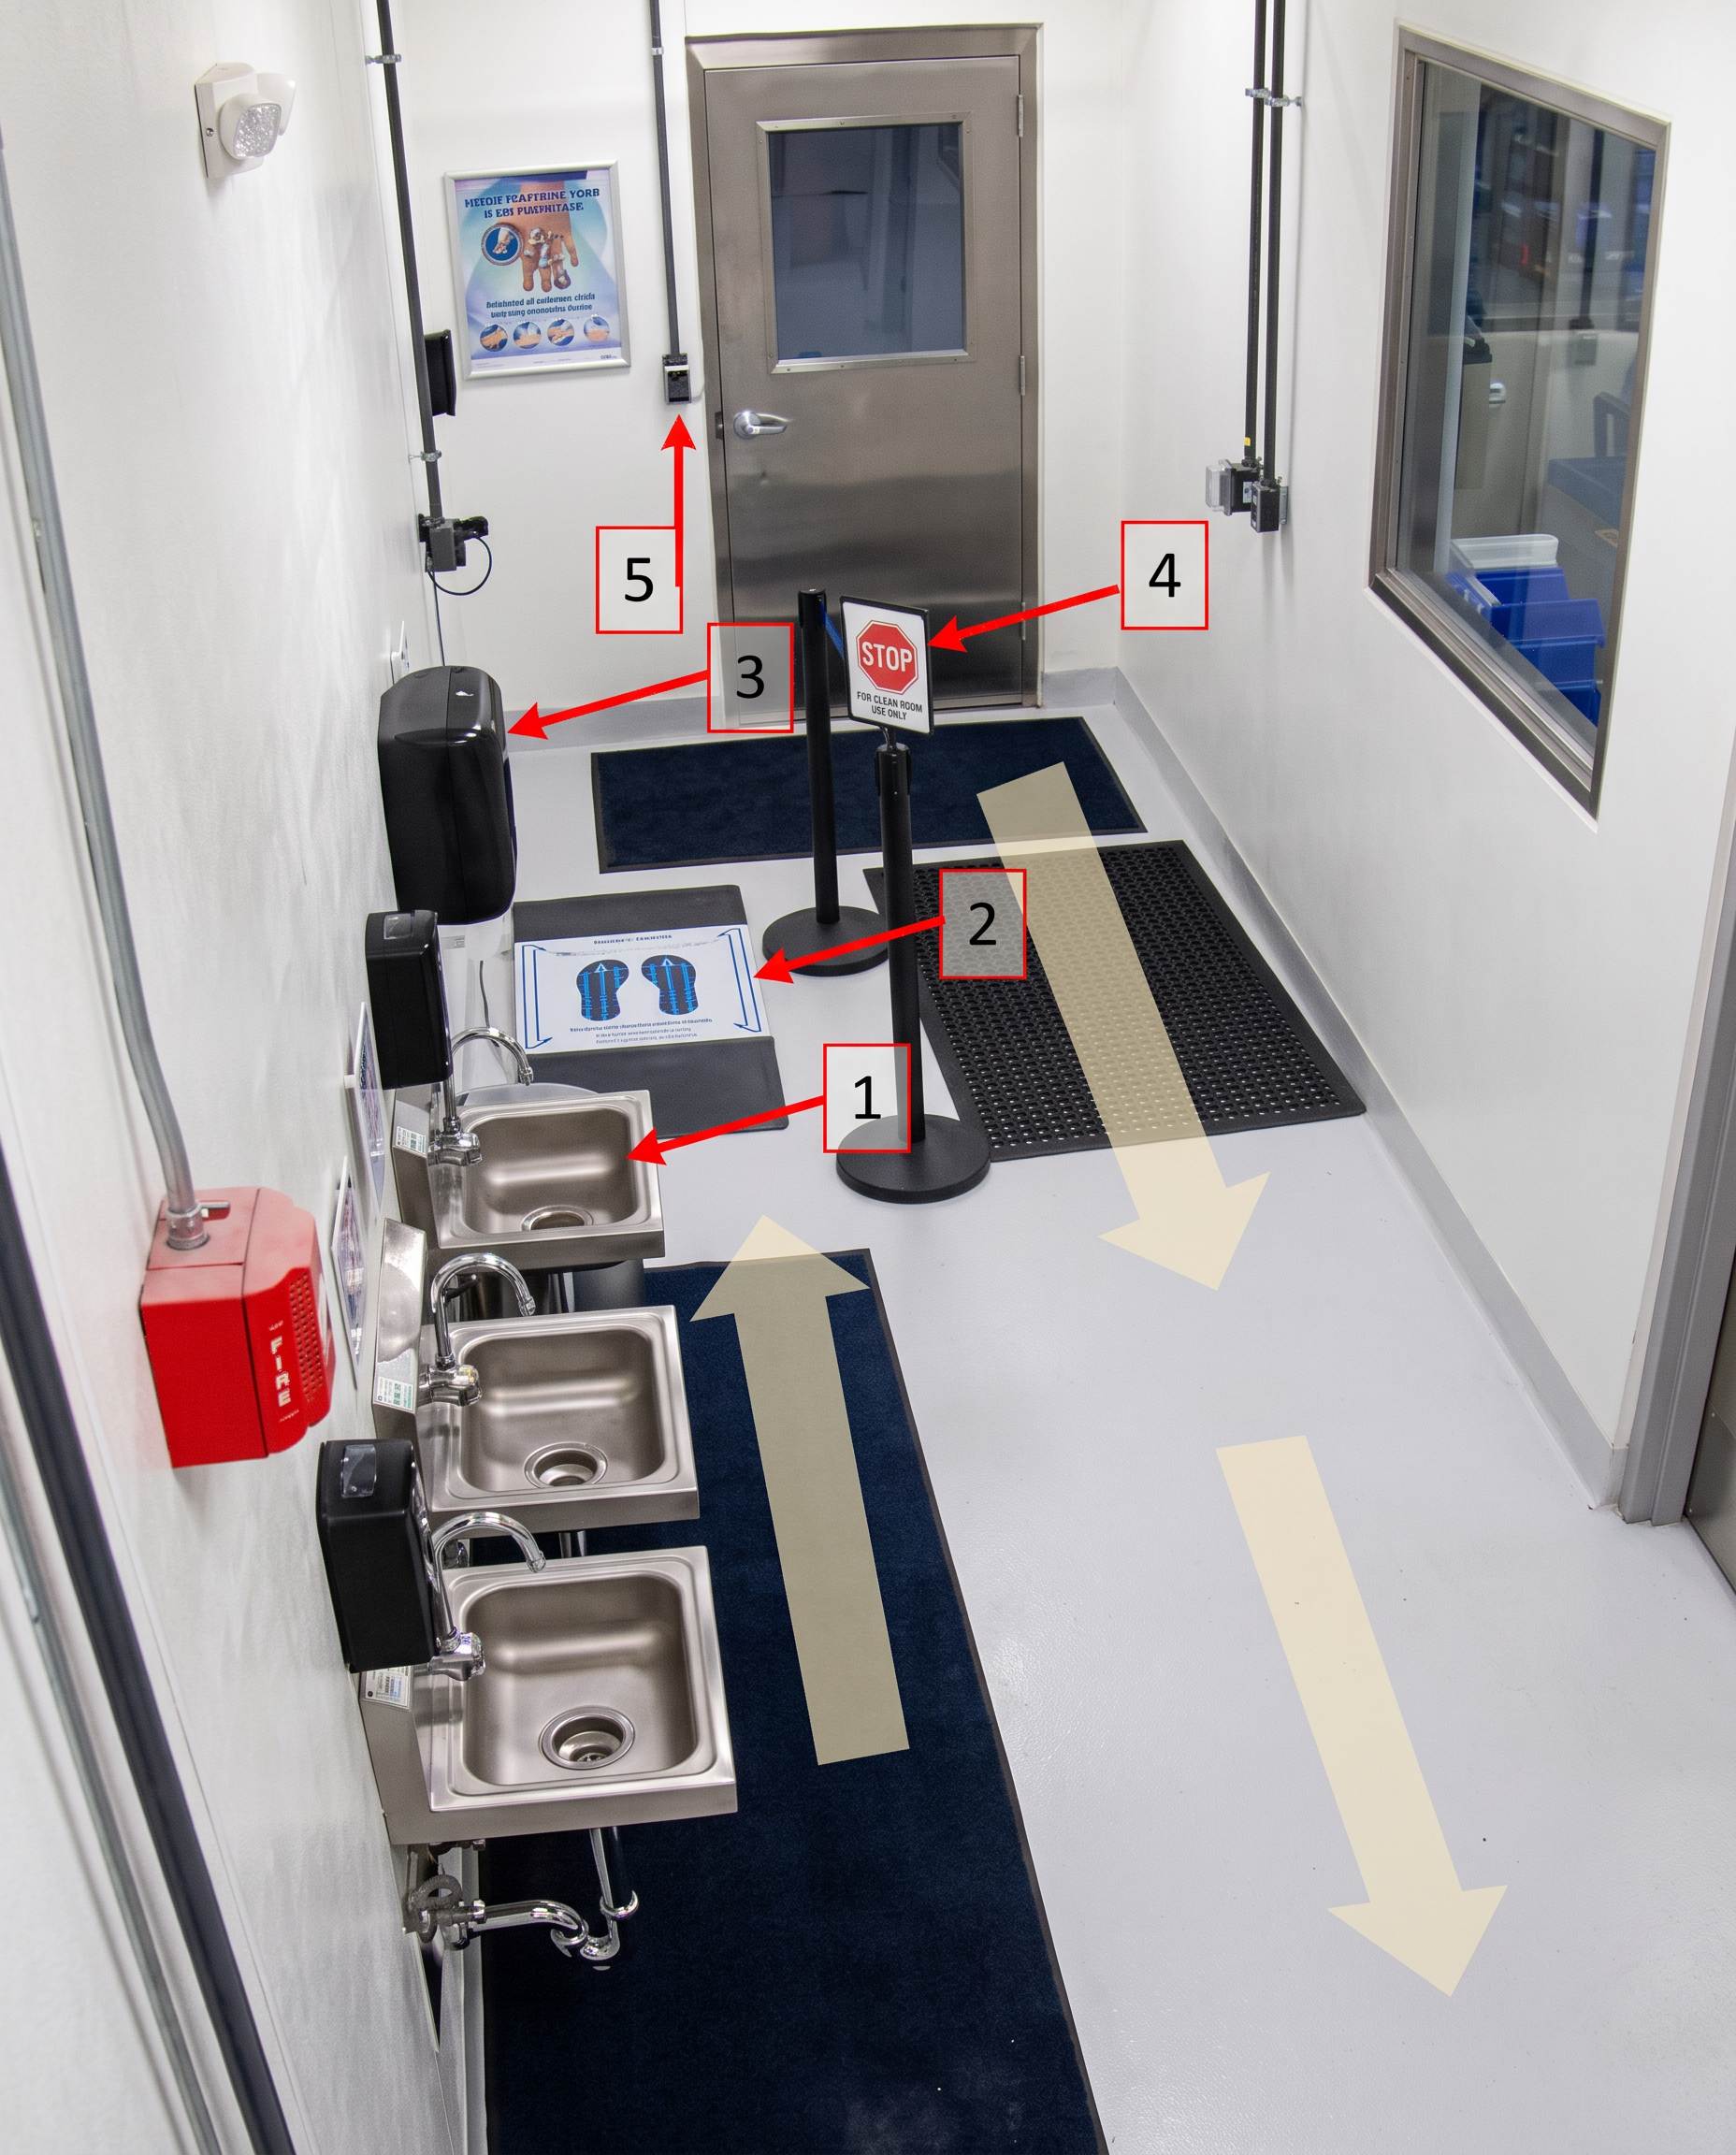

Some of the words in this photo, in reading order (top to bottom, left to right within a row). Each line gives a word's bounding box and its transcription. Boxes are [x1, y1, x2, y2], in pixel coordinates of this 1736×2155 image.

[861, 642, 913, 673] STOP
[857, 691, 872, 702] FOR
[874, 693, 899, 708] CLEAN
[900, 701, 923, 713] ROOM
[871, 704, 887, 716] USE
[888, 708, 907, 720] ONLY
